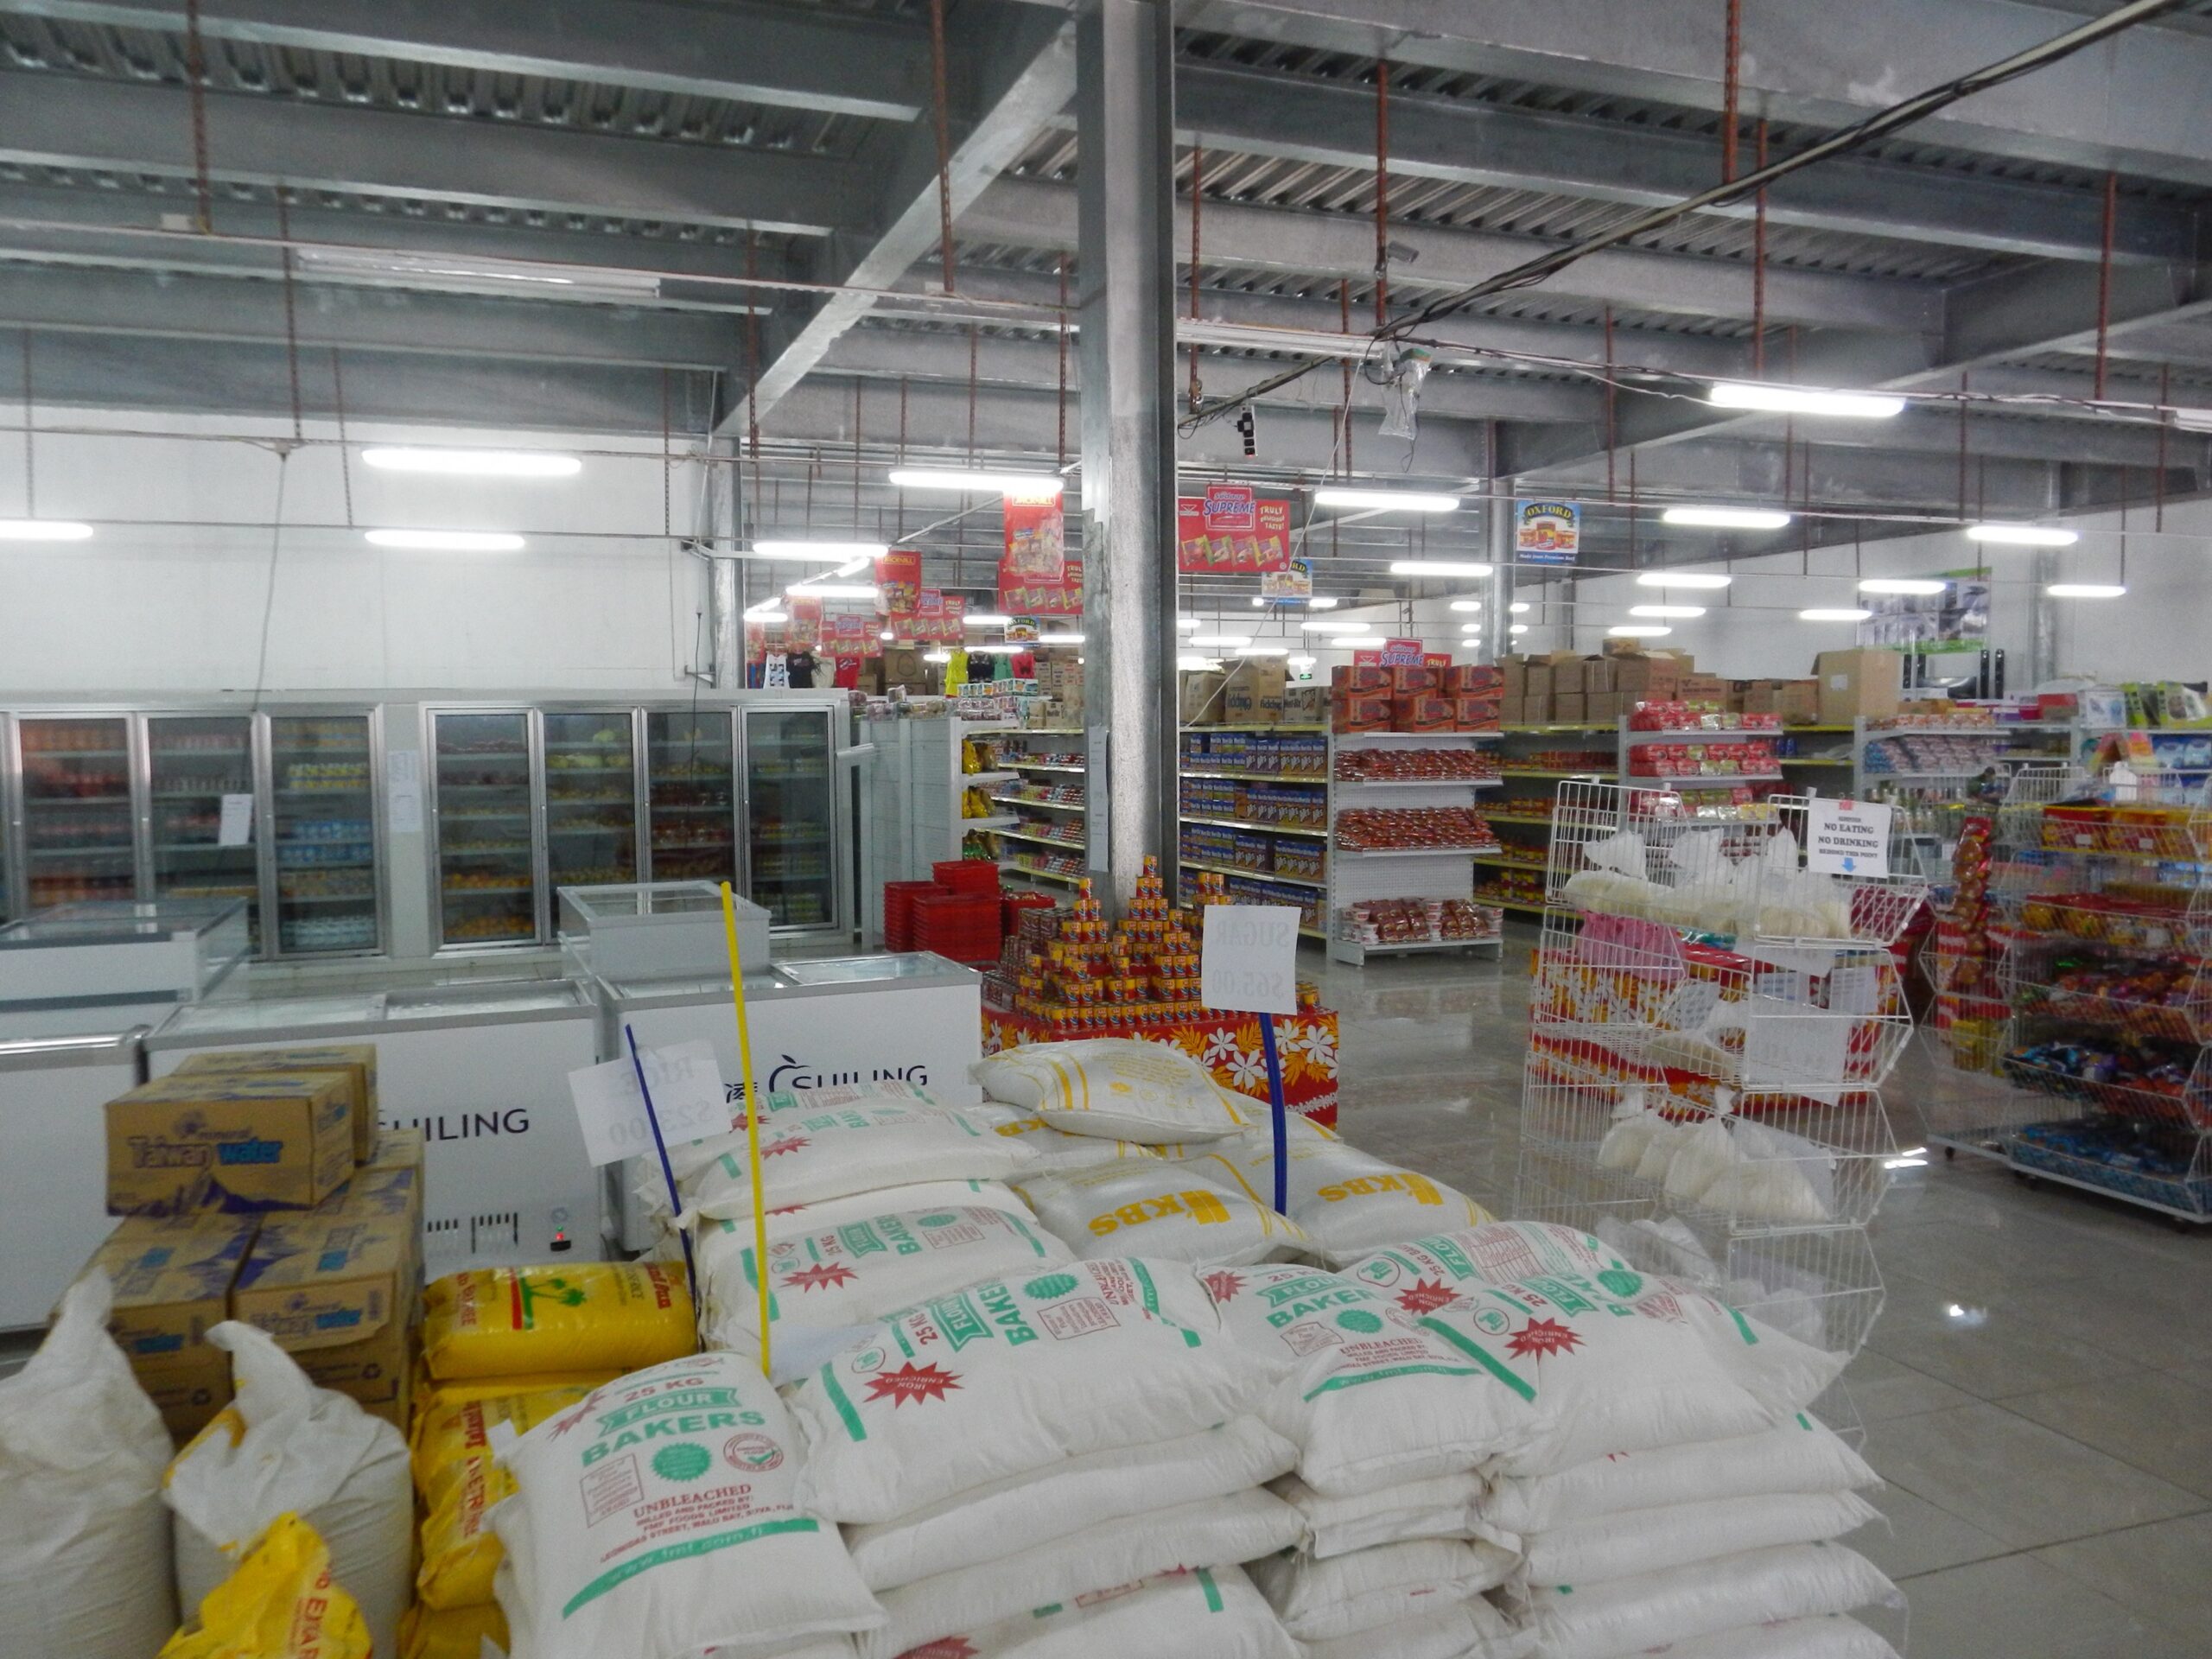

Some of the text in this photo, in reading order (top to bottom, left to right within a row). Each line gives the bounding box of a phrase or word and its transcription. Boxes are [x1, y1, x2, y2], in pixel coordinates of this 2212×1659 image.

[1203, 499, 1255, 516] SUPREME
[1528, 505, 1571, 518] OXFORD
[1381, 652, 1424, 666] SUPREME
[1824, 823, 1873, 834] NO EATING
[1834, 837, 1878, 848] DRINKING
[1317, 1175, 1403, 1203] KBS
[1089, 1194, 1185, 1236] KBS
[1427, 1237, 1465, 1267] FLOU
[1268, 1271, 1294, 1283] 25
[1281, 1275, 1338, 1296] FLOU
[1522, 1293, 1548, 1307] 25
[1524, 1278, 1573, 1303] FLOU
[908, 1313, 938, 1345] 25 KG
[625, 1376, 705, 1403] 25 KG
[898, 1382, 926, 1391] IRON
[626, 1393, 713, 1421] FLOUR
[582, 1410, 766, 1467] BAKERS
[633, 1484, 752, 1518] UNBLEACHED
[637, 1510, 672, 1527] MILLED
[675, 1505, 695, 1515] AND
[697, 1498, 734, 1511] PACKED
[669, 1512, 705, 1524] FOODS
[709, 1503, 750, 1516] LIMITED
